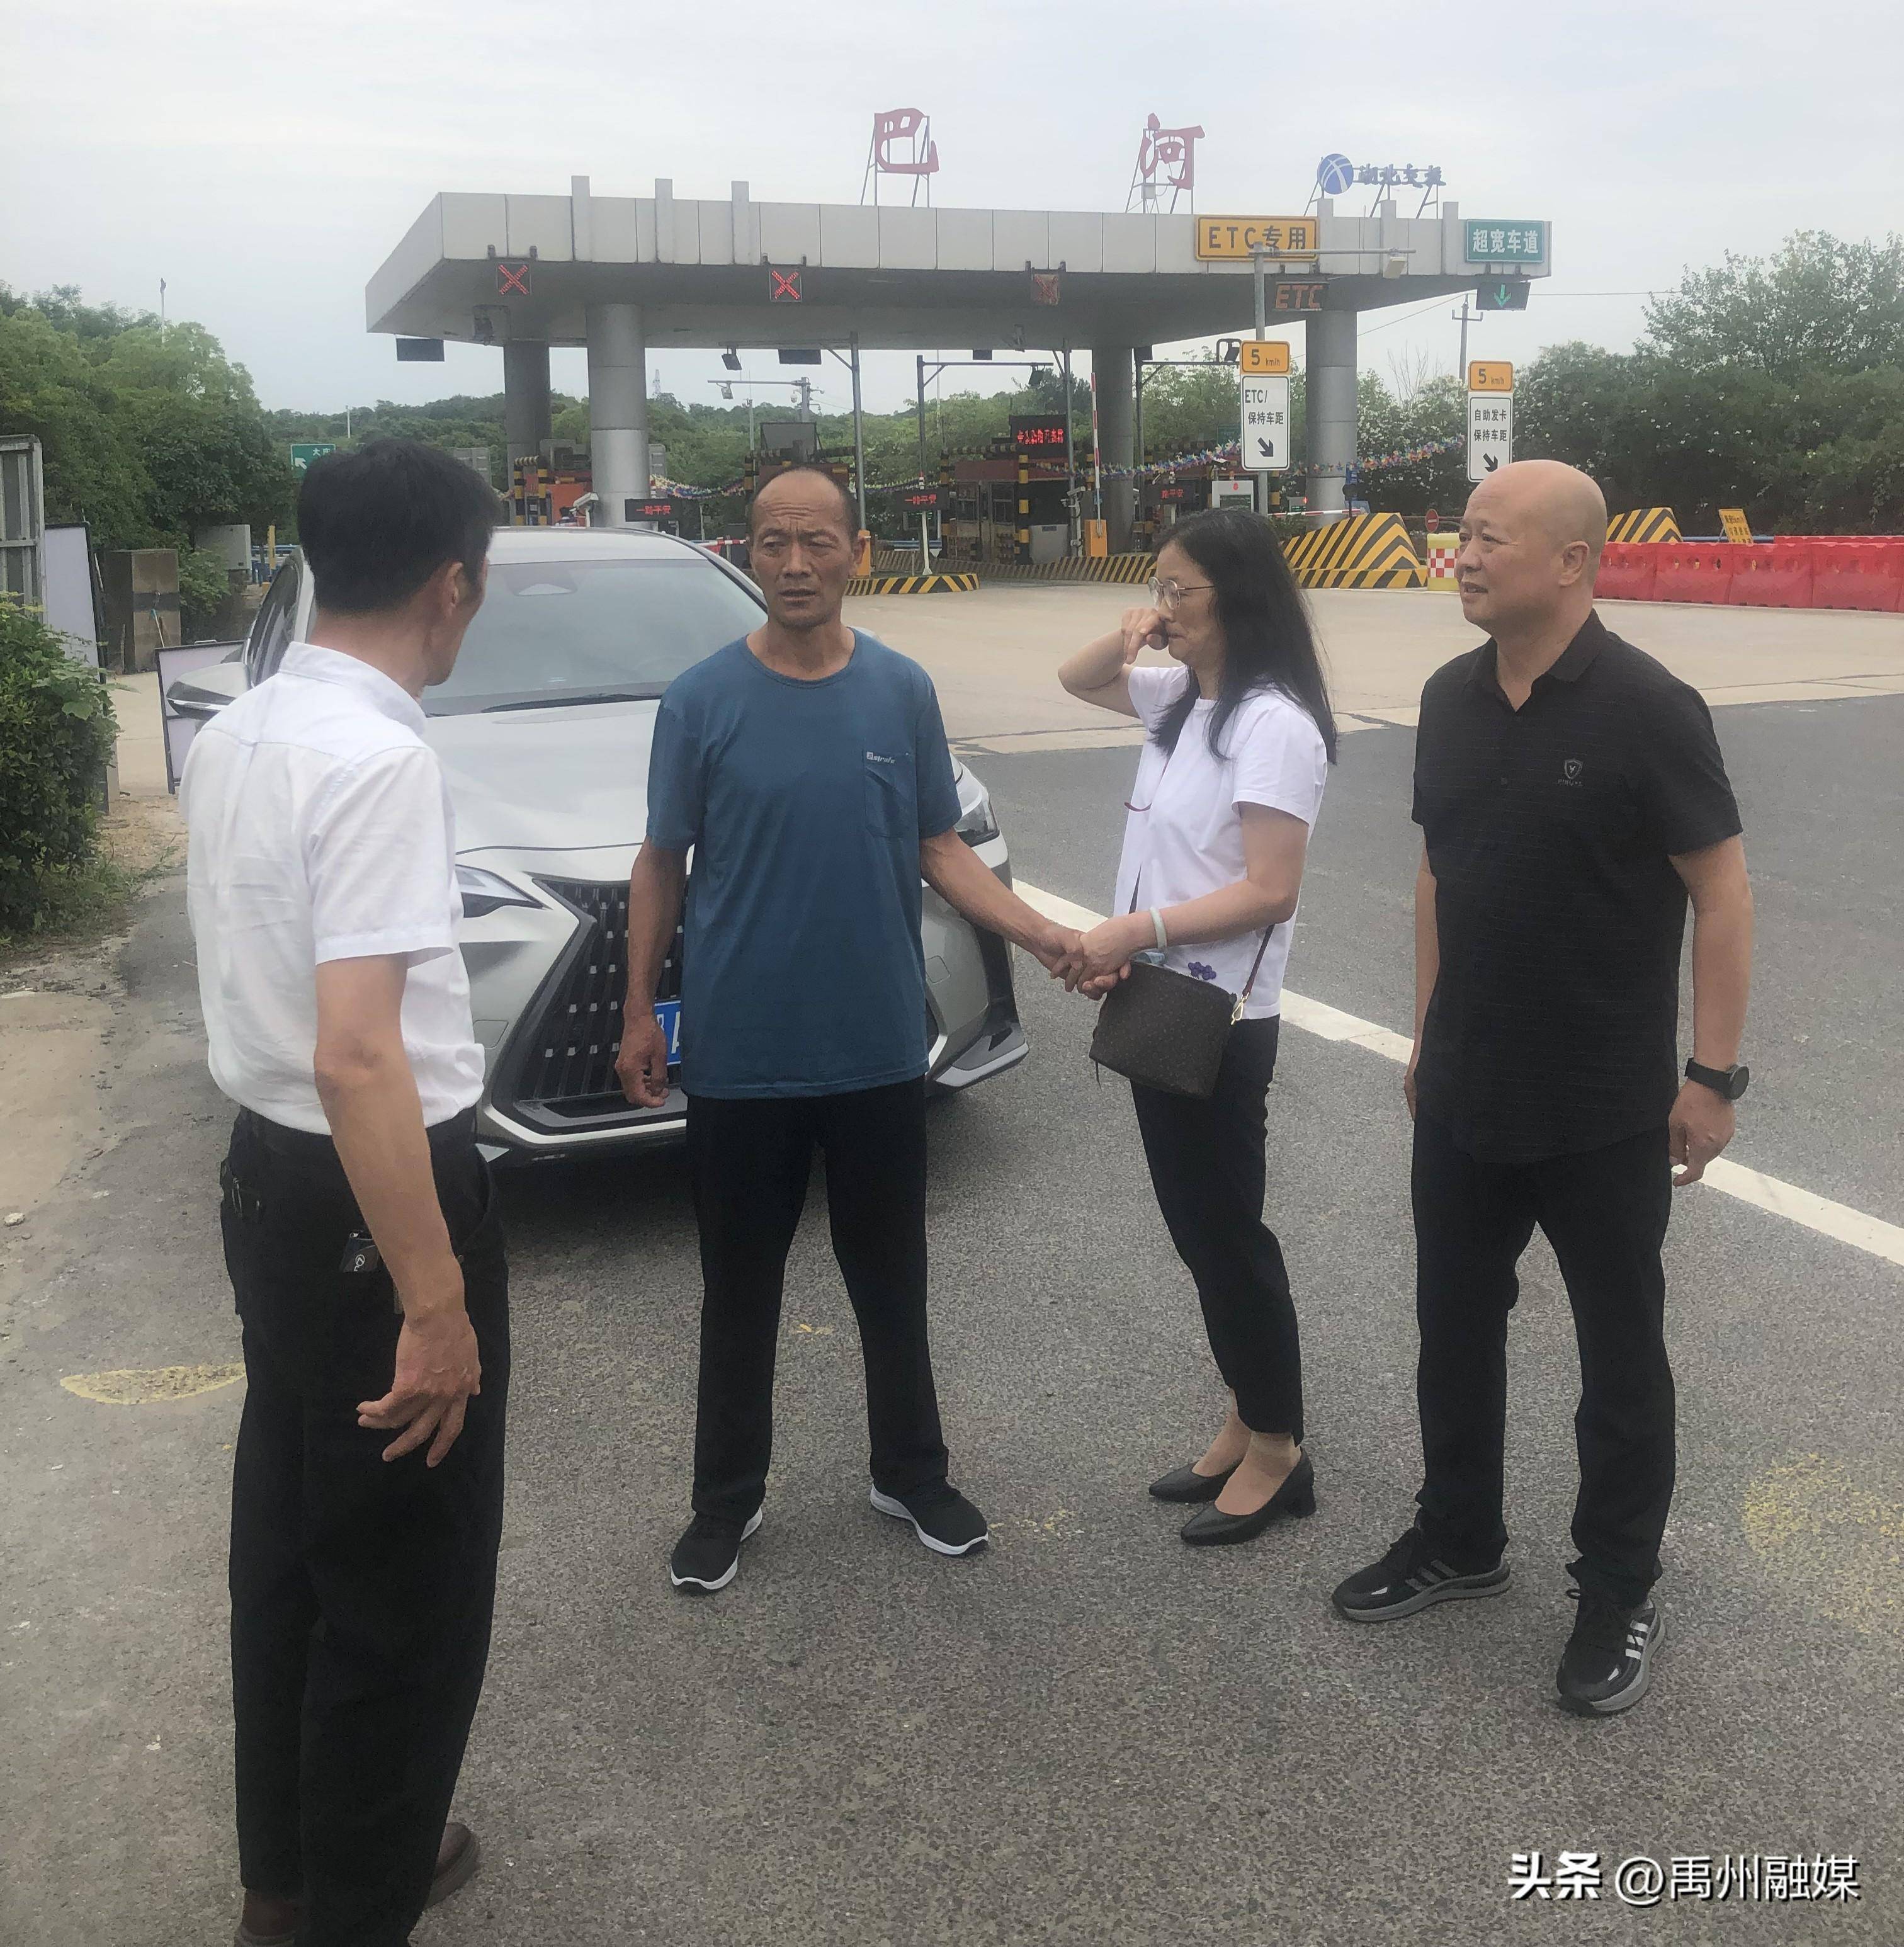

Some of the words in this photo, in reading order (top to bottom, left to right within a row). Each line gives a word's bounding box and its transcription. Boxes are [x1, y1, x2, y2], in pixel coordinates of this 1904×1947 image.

[1209, 225, 1306, 250] ETC专用
[1473, 229, 1538, 253] 超宽车道
[1275, 285, 1323, 309] ETC
[1251, 349, 1260, 366] 5
[1266, 358, 1280, 366] km/h
[1478, 368, 1487, 384] 5
[1491, 377, 1504, 385] km/h
[1245, 389, 1268, 404] ETC/
[1248, 411, 1284, 425] 保持车距
[1475, 409, 1507, 422] 自助发卡
[1473, 429, 1507, 441] 保持车距
